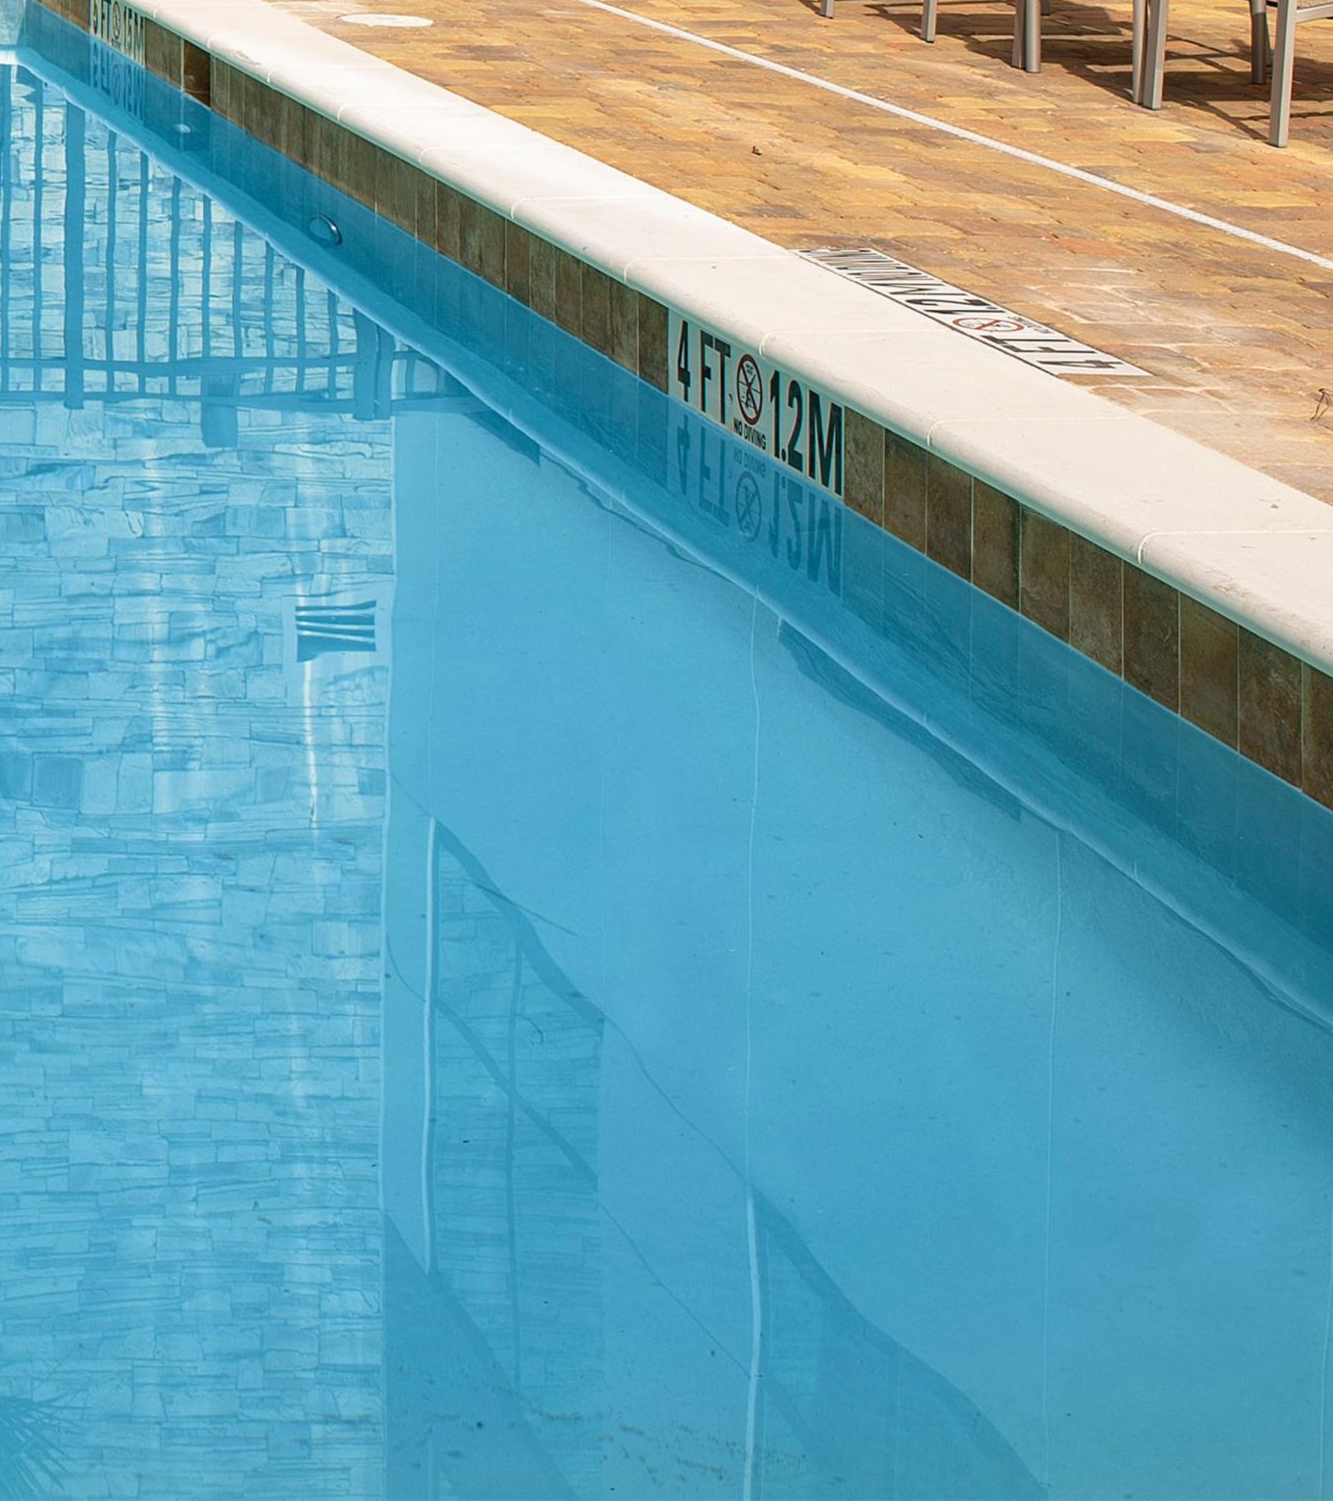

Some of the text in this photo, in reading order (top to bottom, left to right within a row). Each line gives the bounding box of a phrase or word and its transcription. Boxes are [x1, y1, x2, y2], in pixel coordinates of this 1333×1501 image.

[868, 282, 970, 296] M
[981, 334, 1098, 354] FT
[1037, 360, 1126, 369] 4
[677, 319, 843, 497] 4 FT 1.2 M
[734, 417, 767, 451] NO DIVING
